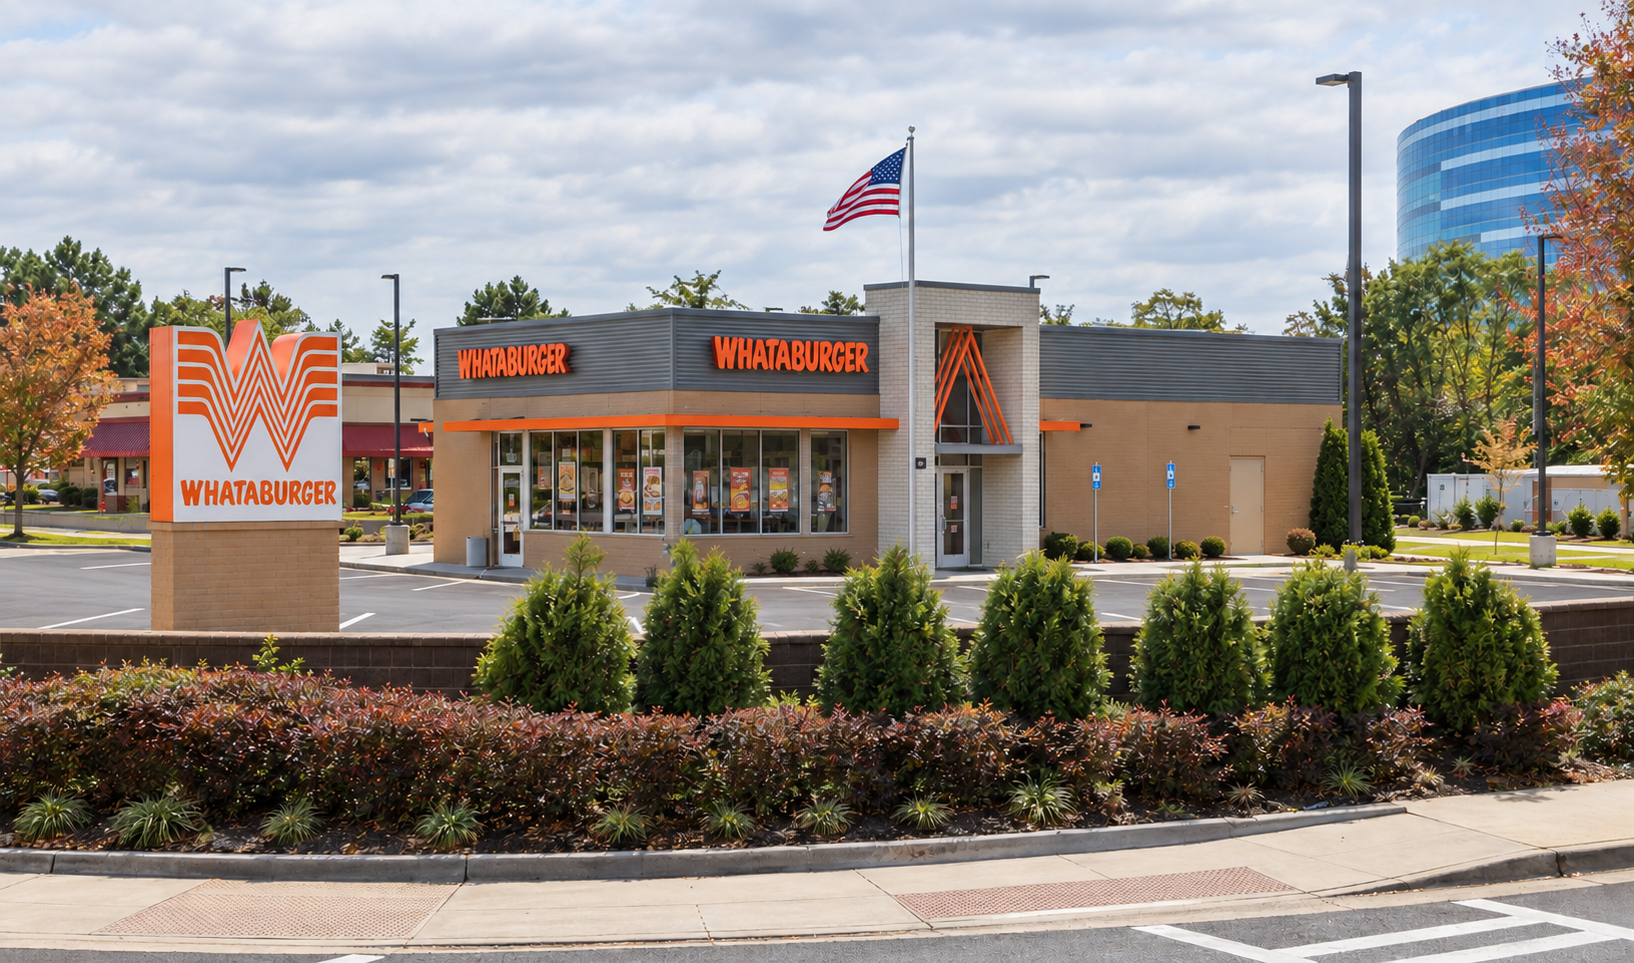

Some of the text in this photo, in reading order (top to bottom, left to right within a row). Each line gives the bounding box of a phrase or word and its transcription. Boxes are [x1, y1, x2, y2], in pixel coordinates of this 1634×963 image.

[458, 343, 571, 379] WHATABURGER
[711, 336, 869, 373] WHATABURGER
[180, 479, 337, 506] WHATABURGER
